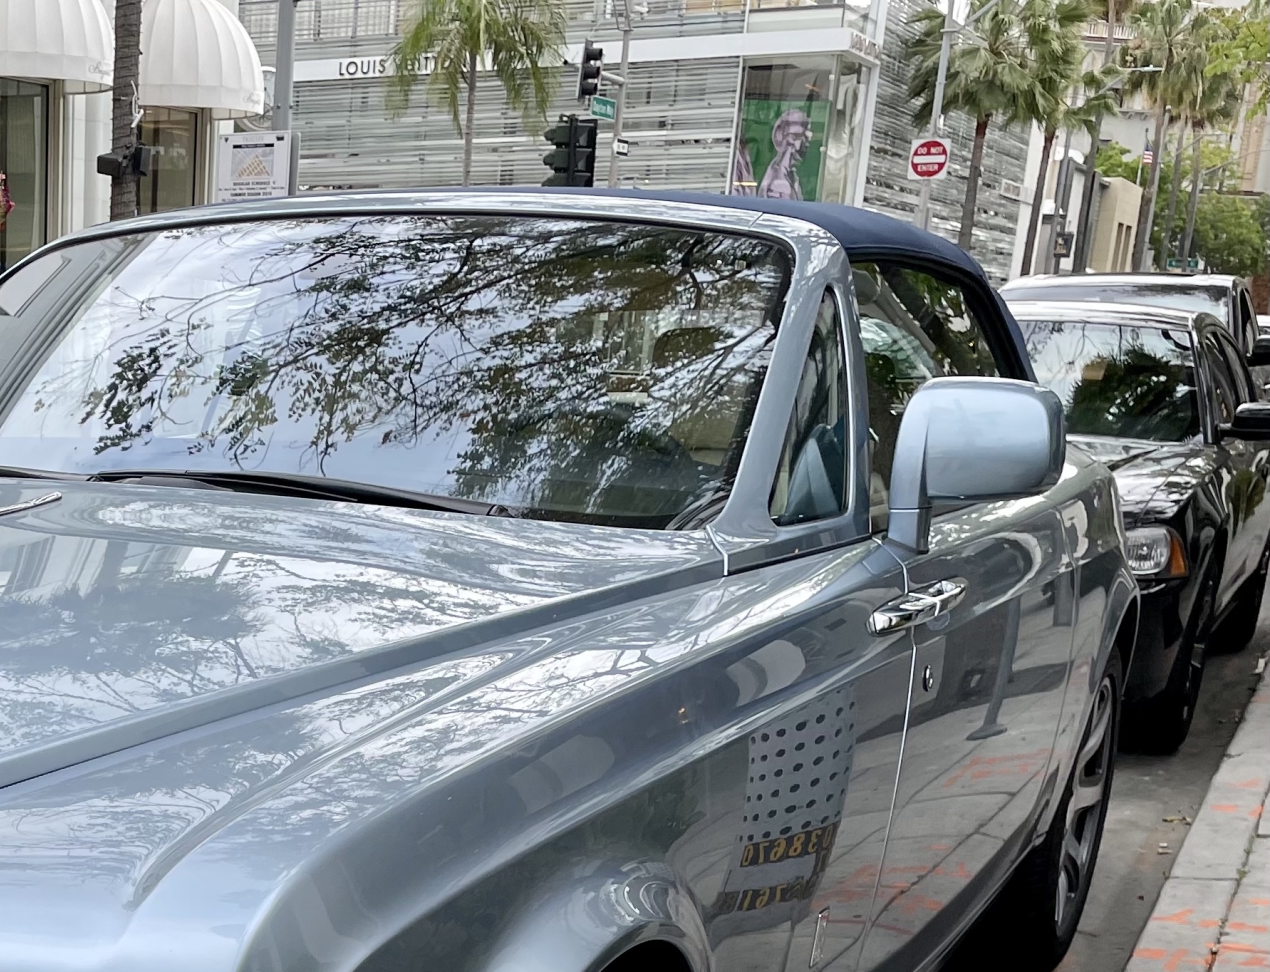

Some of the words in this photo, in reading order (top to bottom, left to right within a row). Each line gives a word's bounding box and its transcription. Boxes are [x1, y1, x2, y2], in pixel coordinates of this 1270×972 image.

[338, 59, 387, 77] LOUIS
[917, 147, 928, 155] DO
[930, 146, 944, 154] NOT
[917, 163, 939, 172] ENTER
